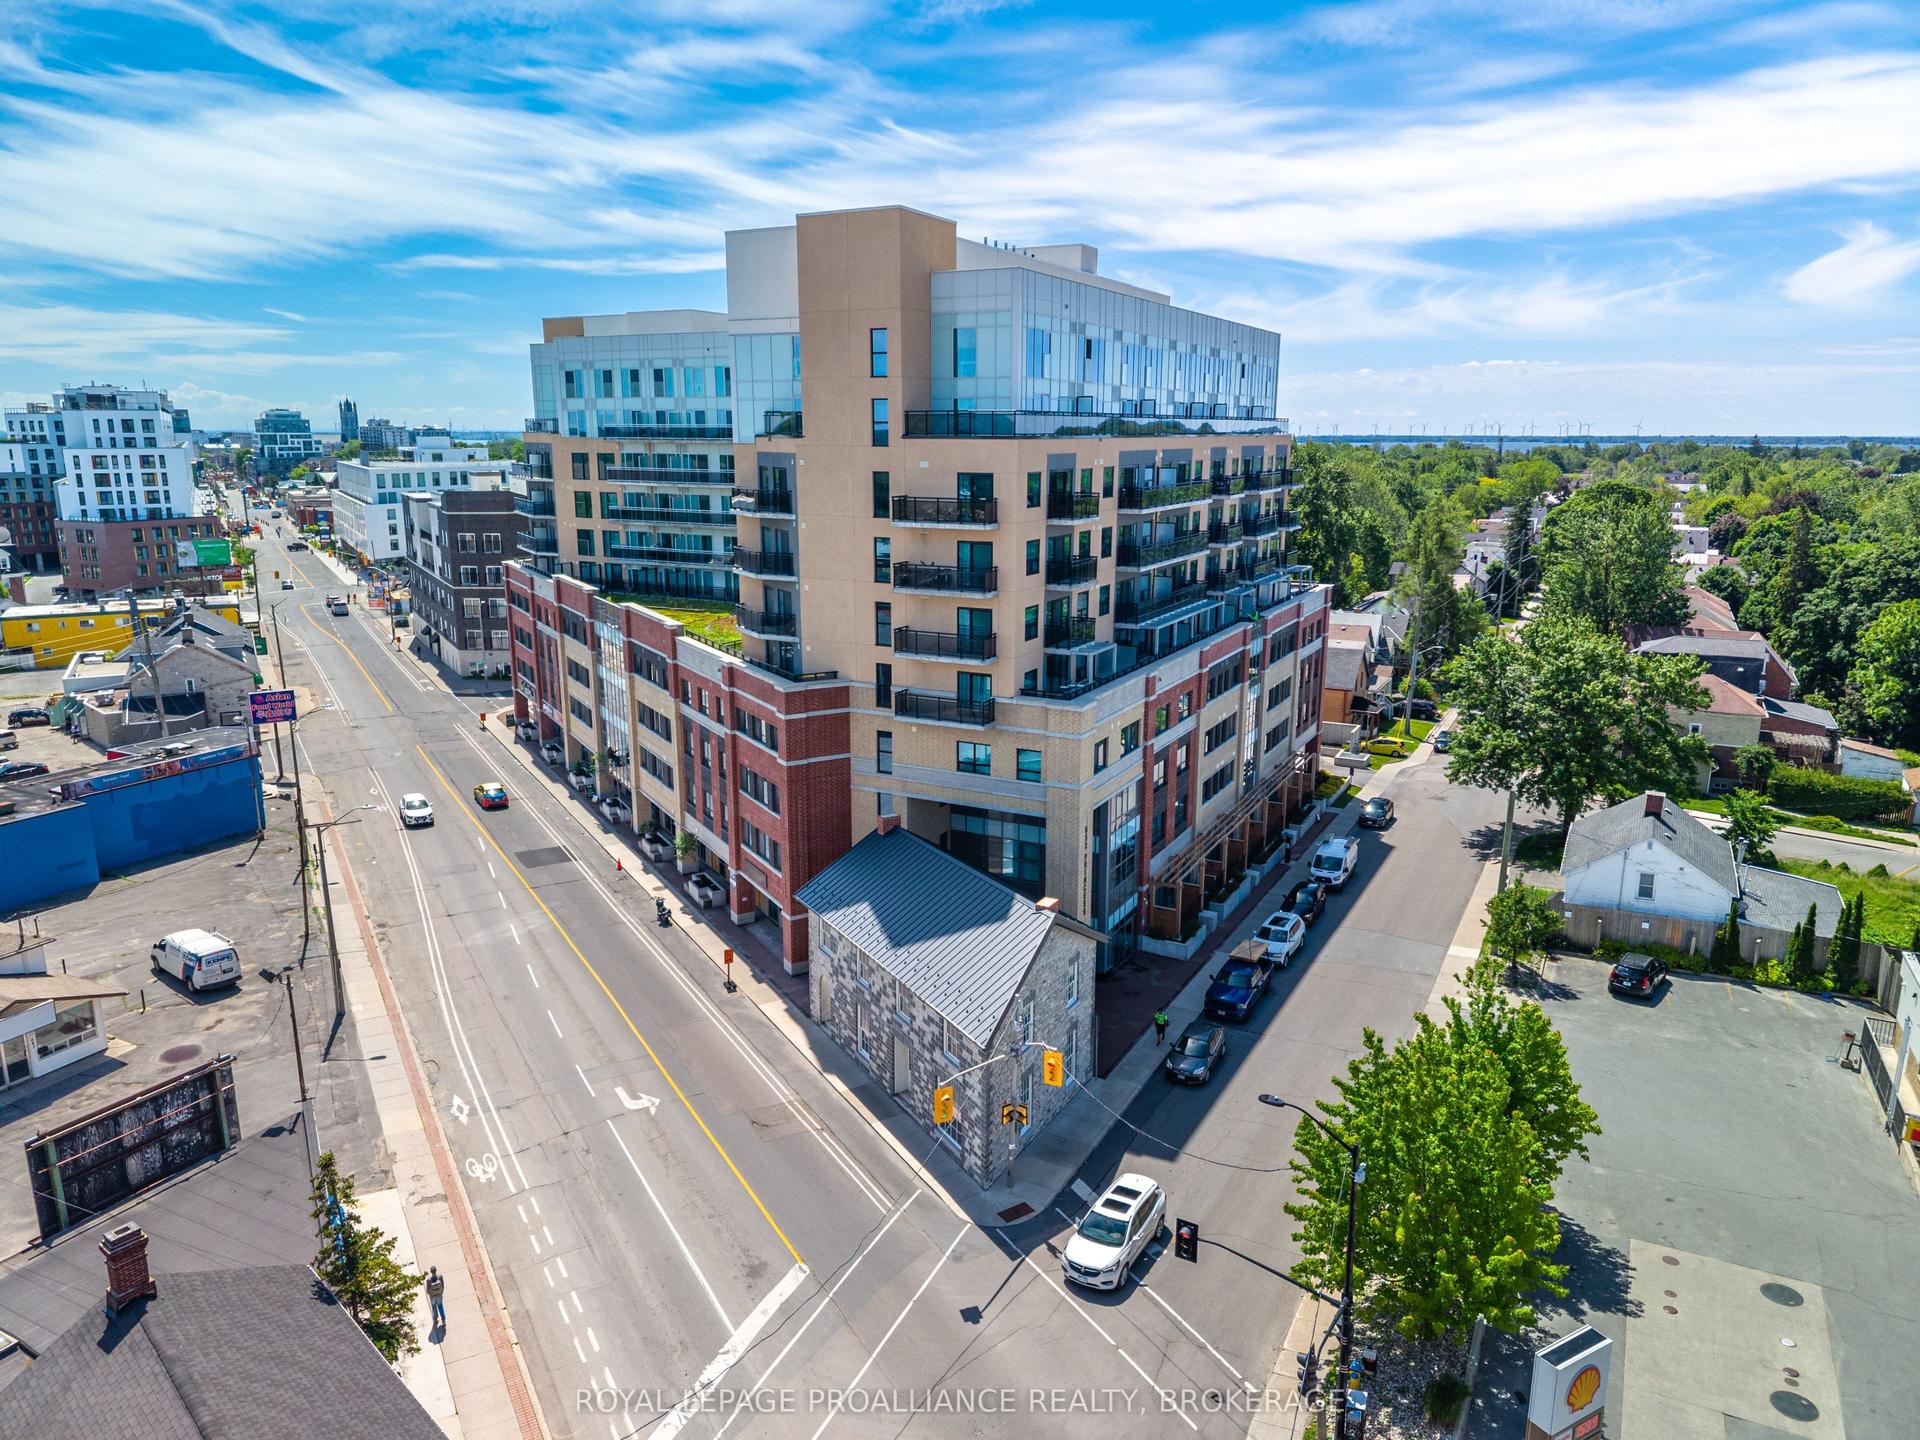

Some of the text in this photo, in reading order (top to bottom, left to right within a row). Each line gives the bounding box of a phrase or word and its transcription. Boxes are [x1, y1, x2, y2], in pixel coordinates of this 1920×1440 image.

[266, 693, 291, 701] Asian
[250, 701, 295, 712] Food World
[206, 953, 232, 966] KEMPE
